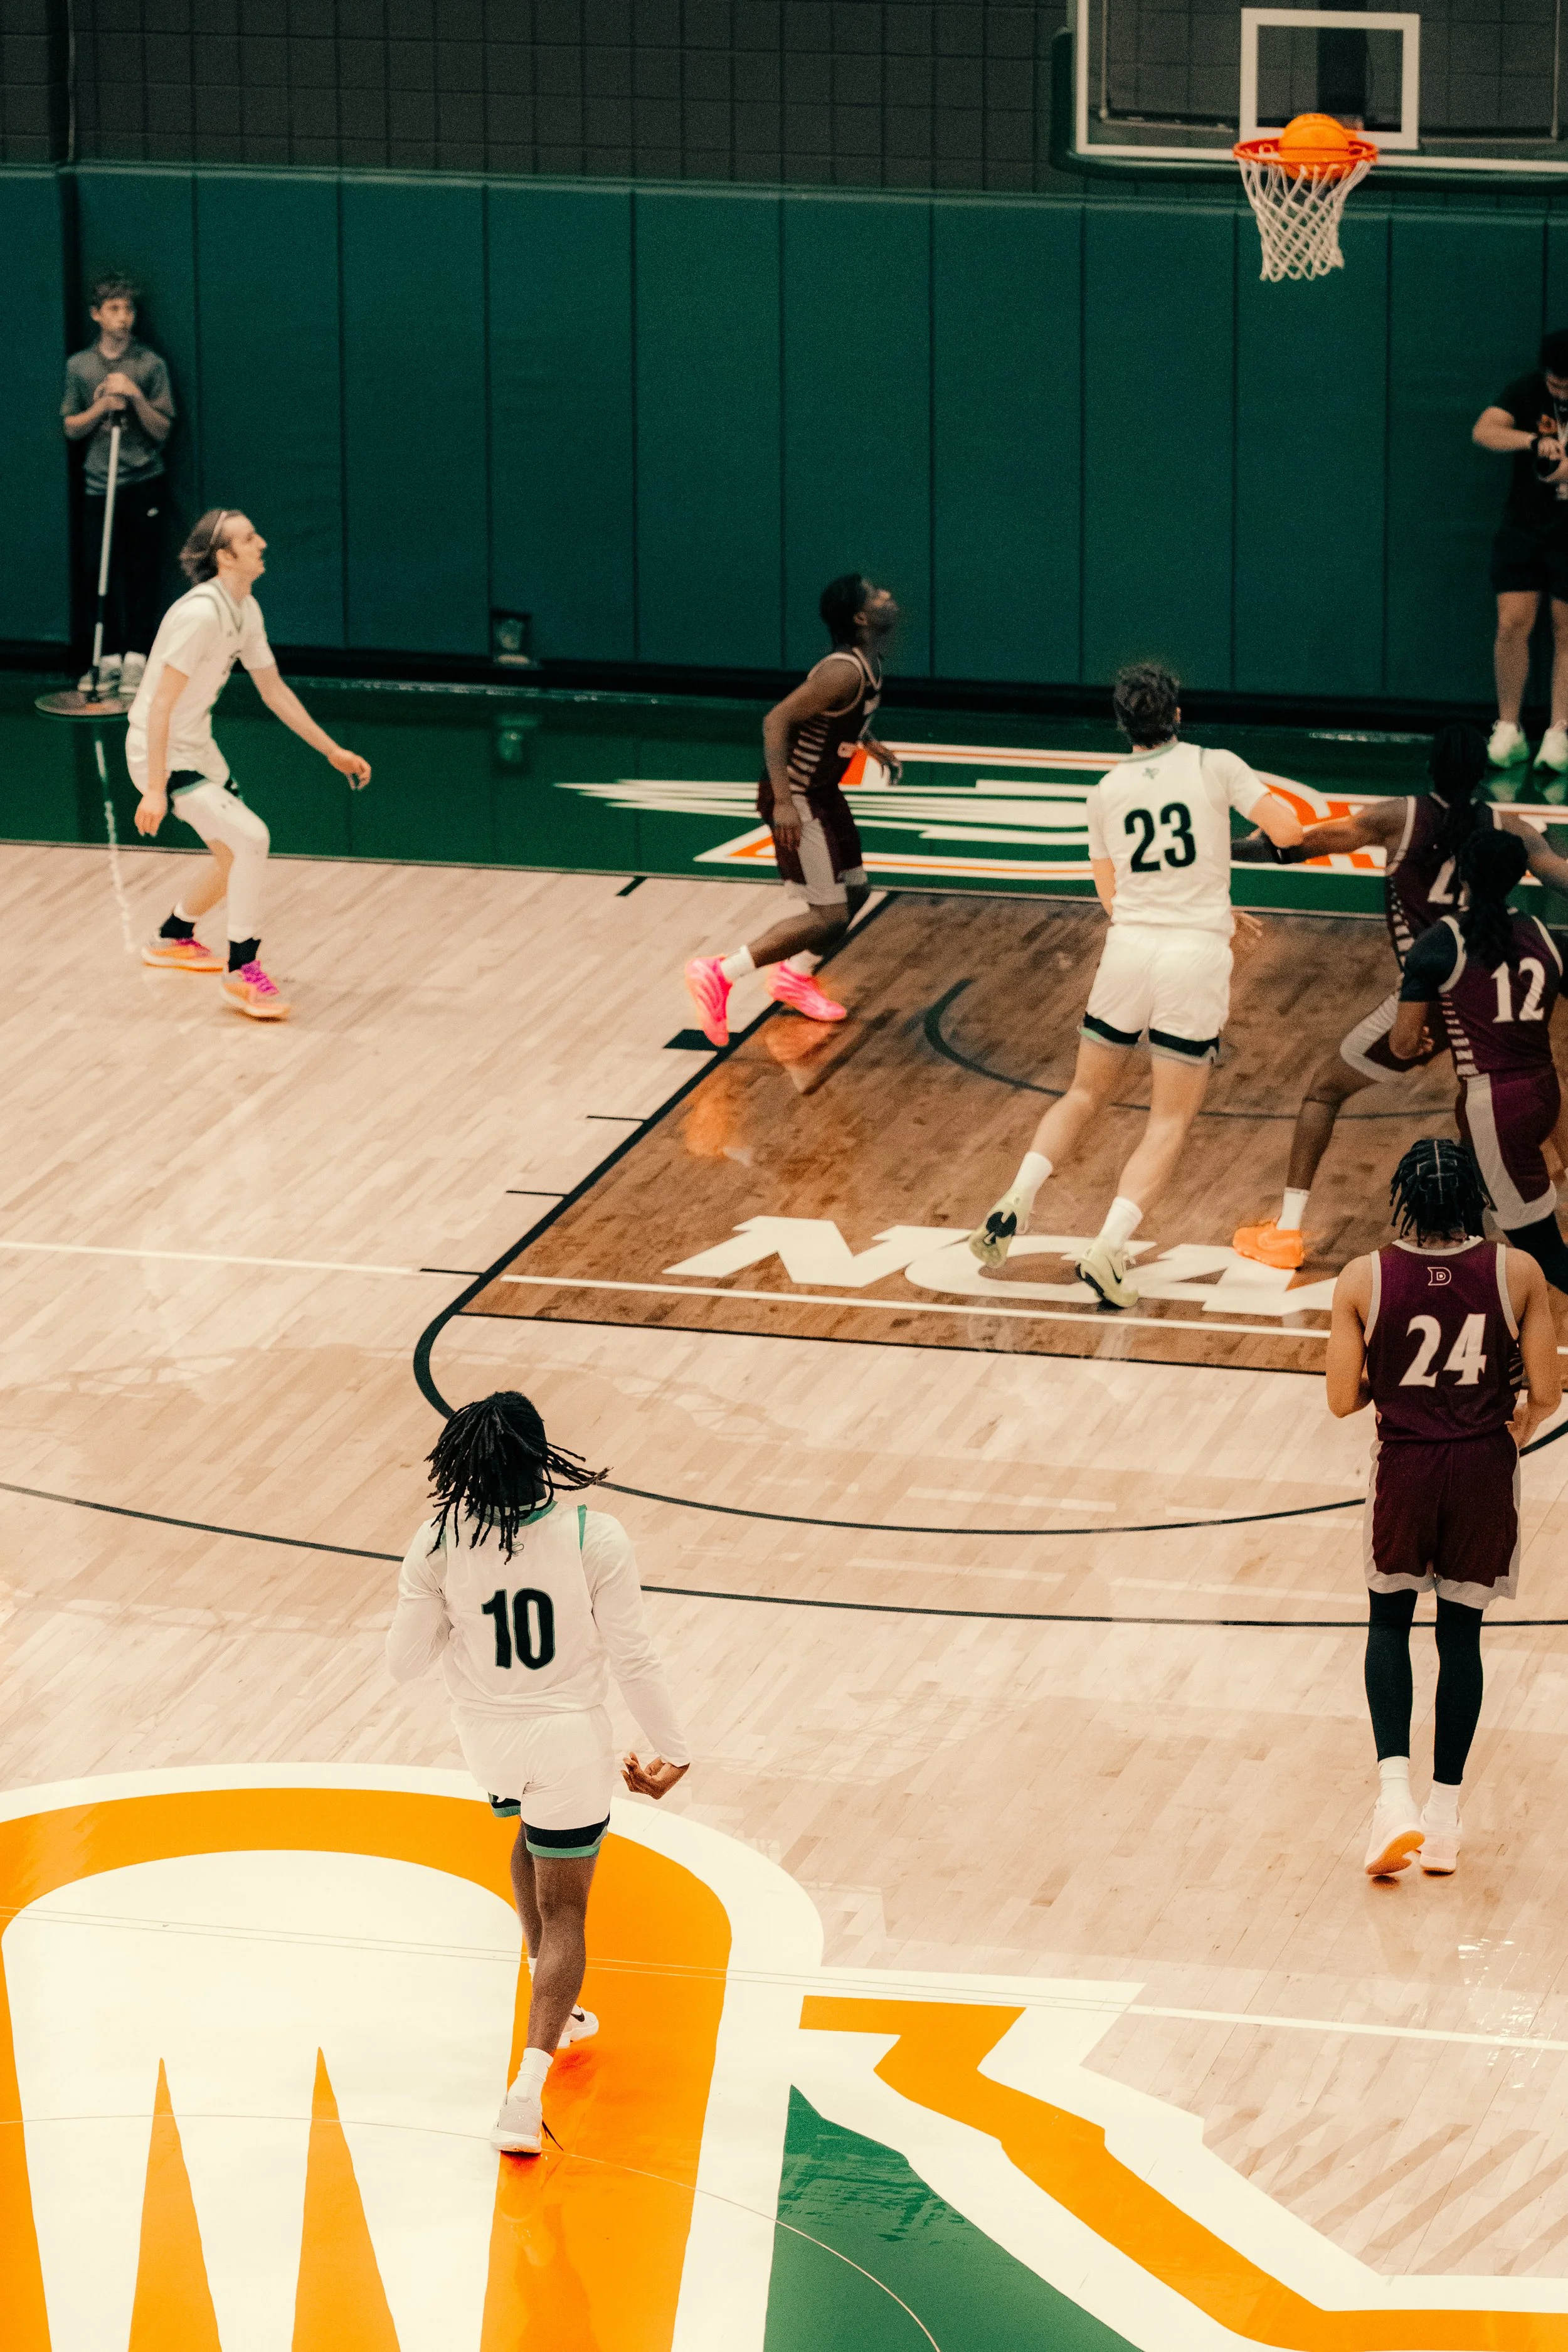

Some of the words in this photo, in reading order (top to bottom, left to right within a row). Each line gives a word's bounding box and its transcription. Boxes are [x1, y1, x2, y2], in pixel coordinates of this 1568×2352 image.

[1124, 802, 1197, 873] 23
[1490, 956, 1545, 1024] 12
[1398, 1313, 1487, 1388] 24
[481, 1587, 556, 1670] 10
